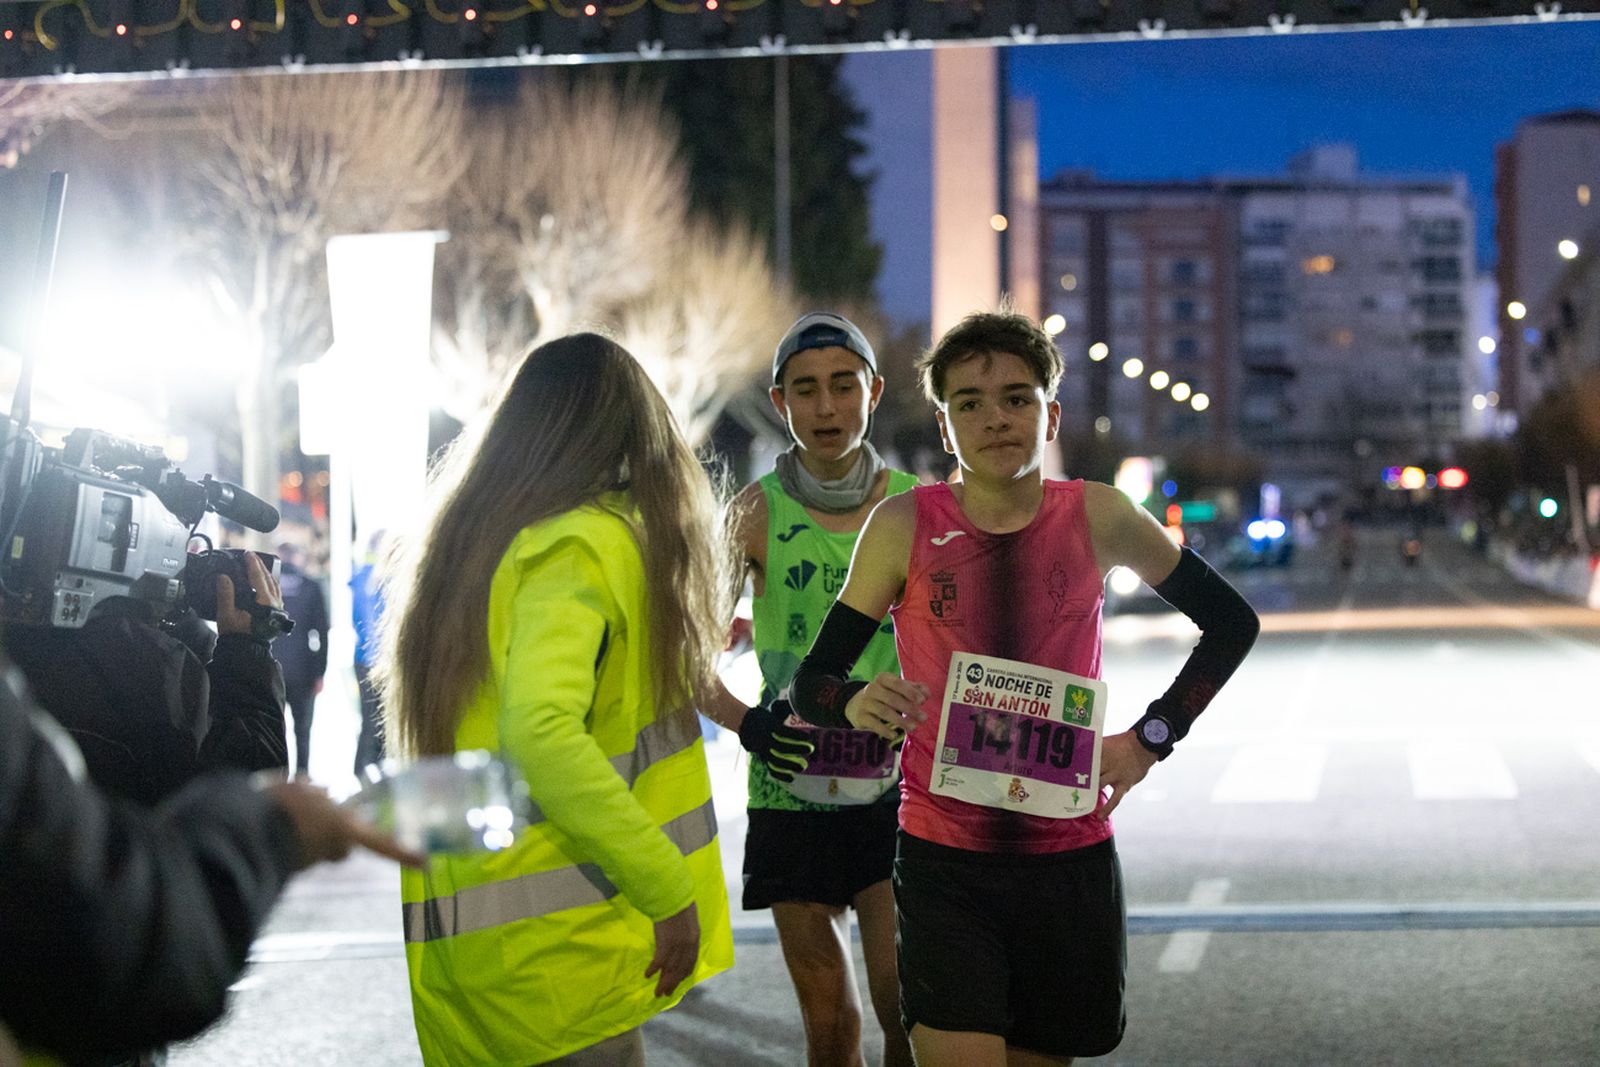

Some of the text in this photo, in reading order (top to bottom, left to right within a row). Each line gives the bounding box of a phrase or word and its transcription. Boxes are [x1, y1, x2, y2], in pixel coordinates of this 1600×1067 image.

[967, 667, 982, 679] 43
[985, 675, 1054, 699] NOCHE DE
[963, 689, 995, 706] SAN
[997, 694, 1051, 718] ANTÓN
[969, 713, 1075, 769] 14119
